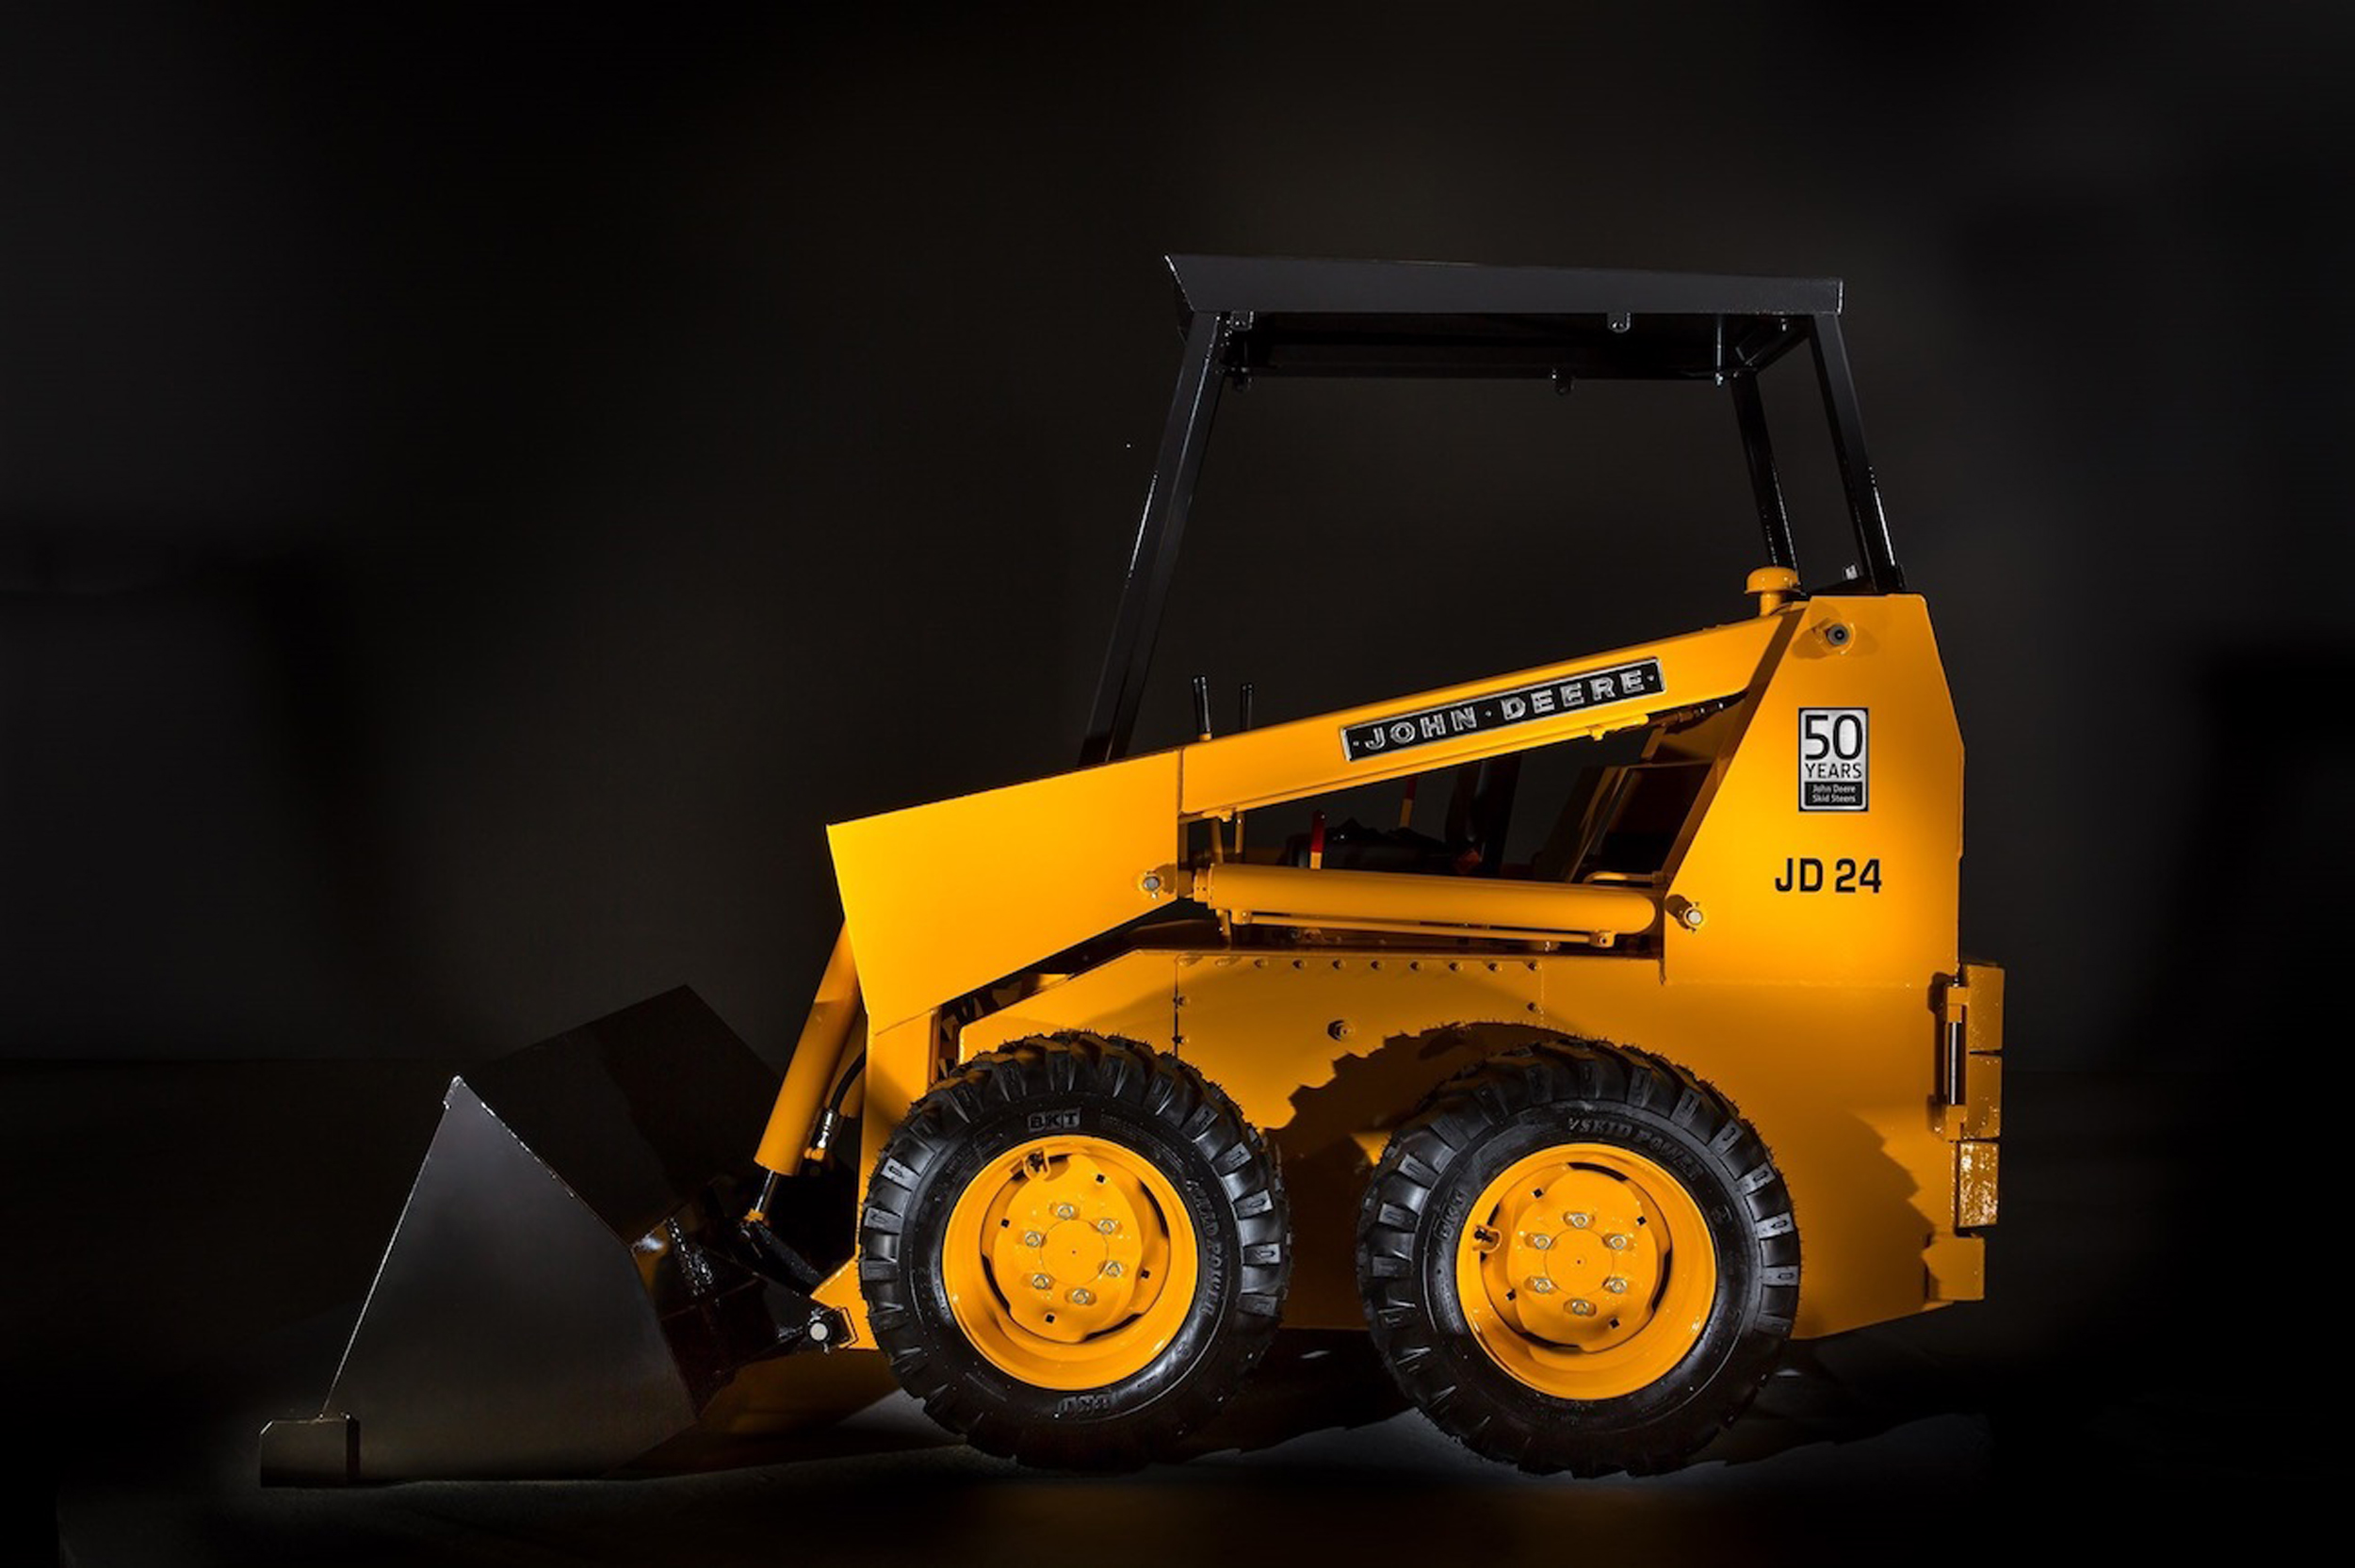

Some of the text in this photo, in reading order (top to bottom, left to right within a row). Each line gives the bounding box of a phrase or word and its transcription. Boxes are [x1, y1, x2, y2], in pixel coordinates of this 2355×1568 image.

[1364, 670, 1645, 750] JOHN DEERE
[1805, 714, 1863, 760] 50
[1805, 763, 1862, 779] YEARS
[1812, 784, 1856, 793] John Deere
[1775, 858, 1882, 893] JD 24
[1029, 1110, 1080, 1131] BKT
